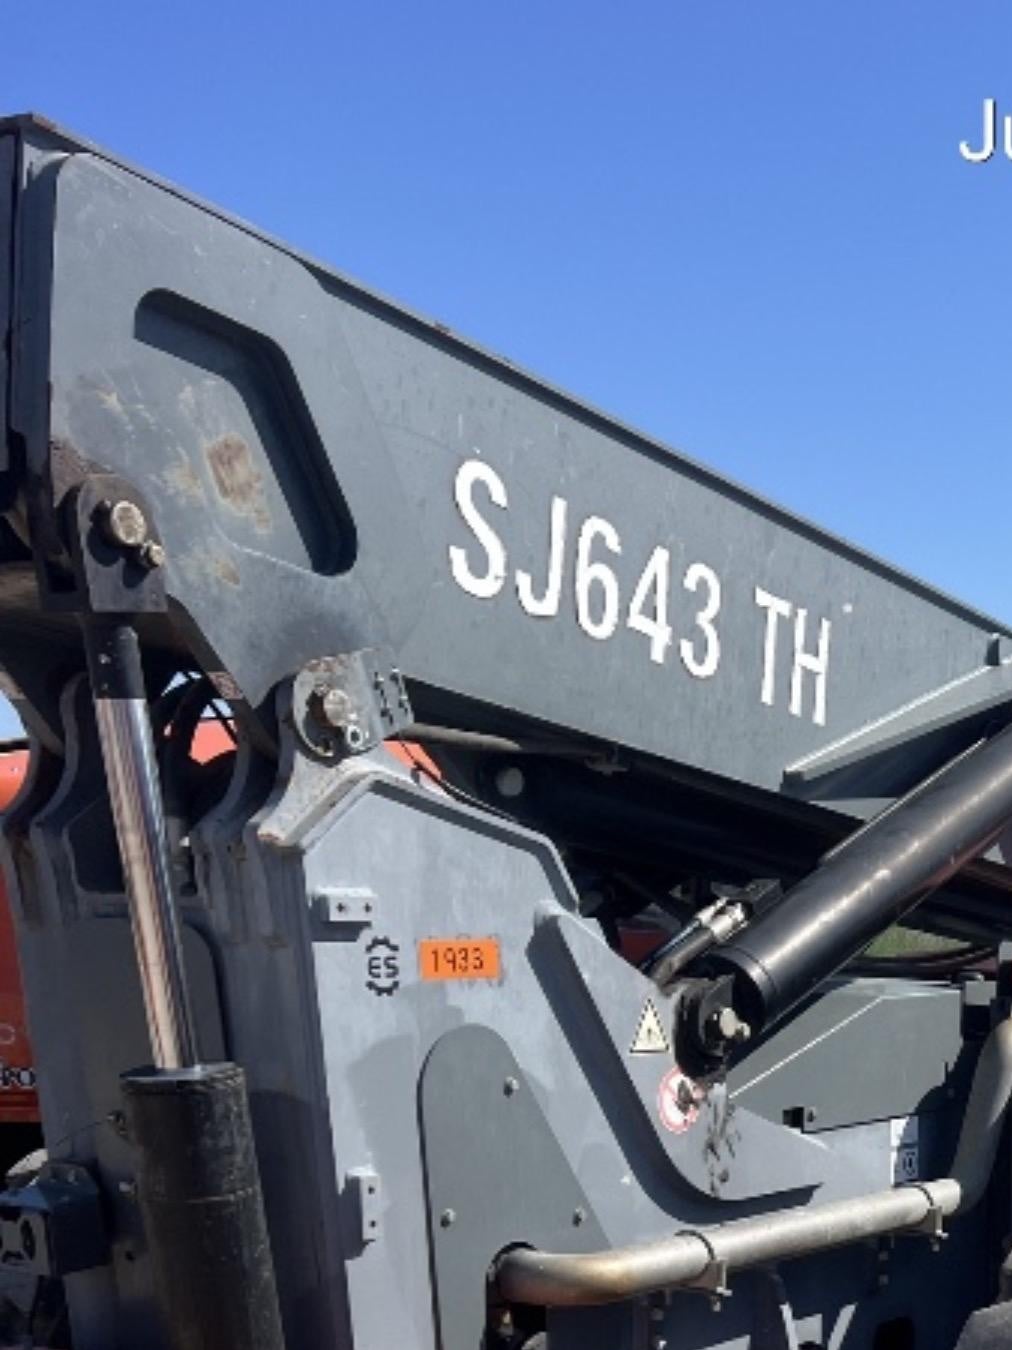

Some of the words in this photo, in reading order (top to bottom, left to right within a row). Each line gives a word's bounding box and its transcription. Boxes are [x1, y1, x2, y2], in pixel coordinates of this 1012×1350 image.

[449, 459, 721, 679] SJ643
[755, 586, 831, 726] TH
[367, 956, 399, 979] ES
